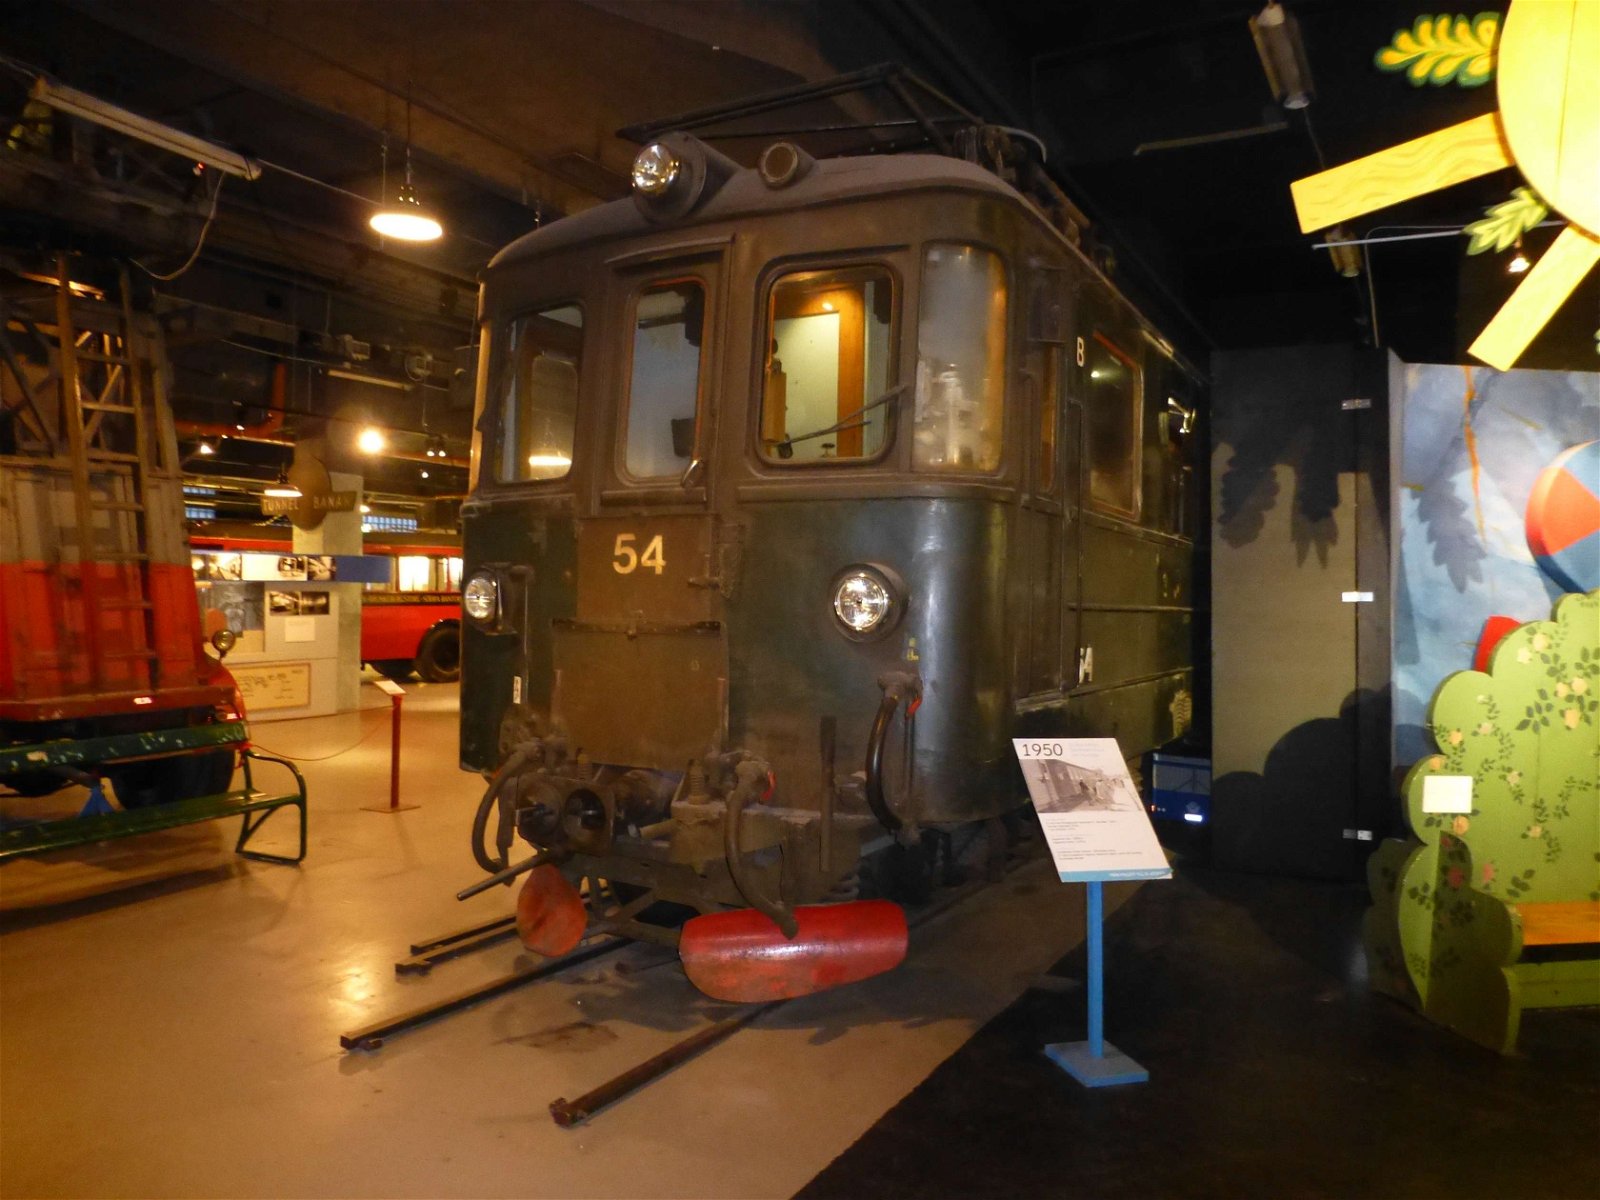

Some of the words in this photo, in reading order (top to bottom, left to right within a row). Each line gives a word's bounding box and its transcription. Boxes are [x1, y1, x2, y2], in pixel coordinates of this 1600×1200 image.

[1077, 336, 1084, 367] B
[612, 533, 667, 575] 54
[1022, 743, 1063, 757] 1950
